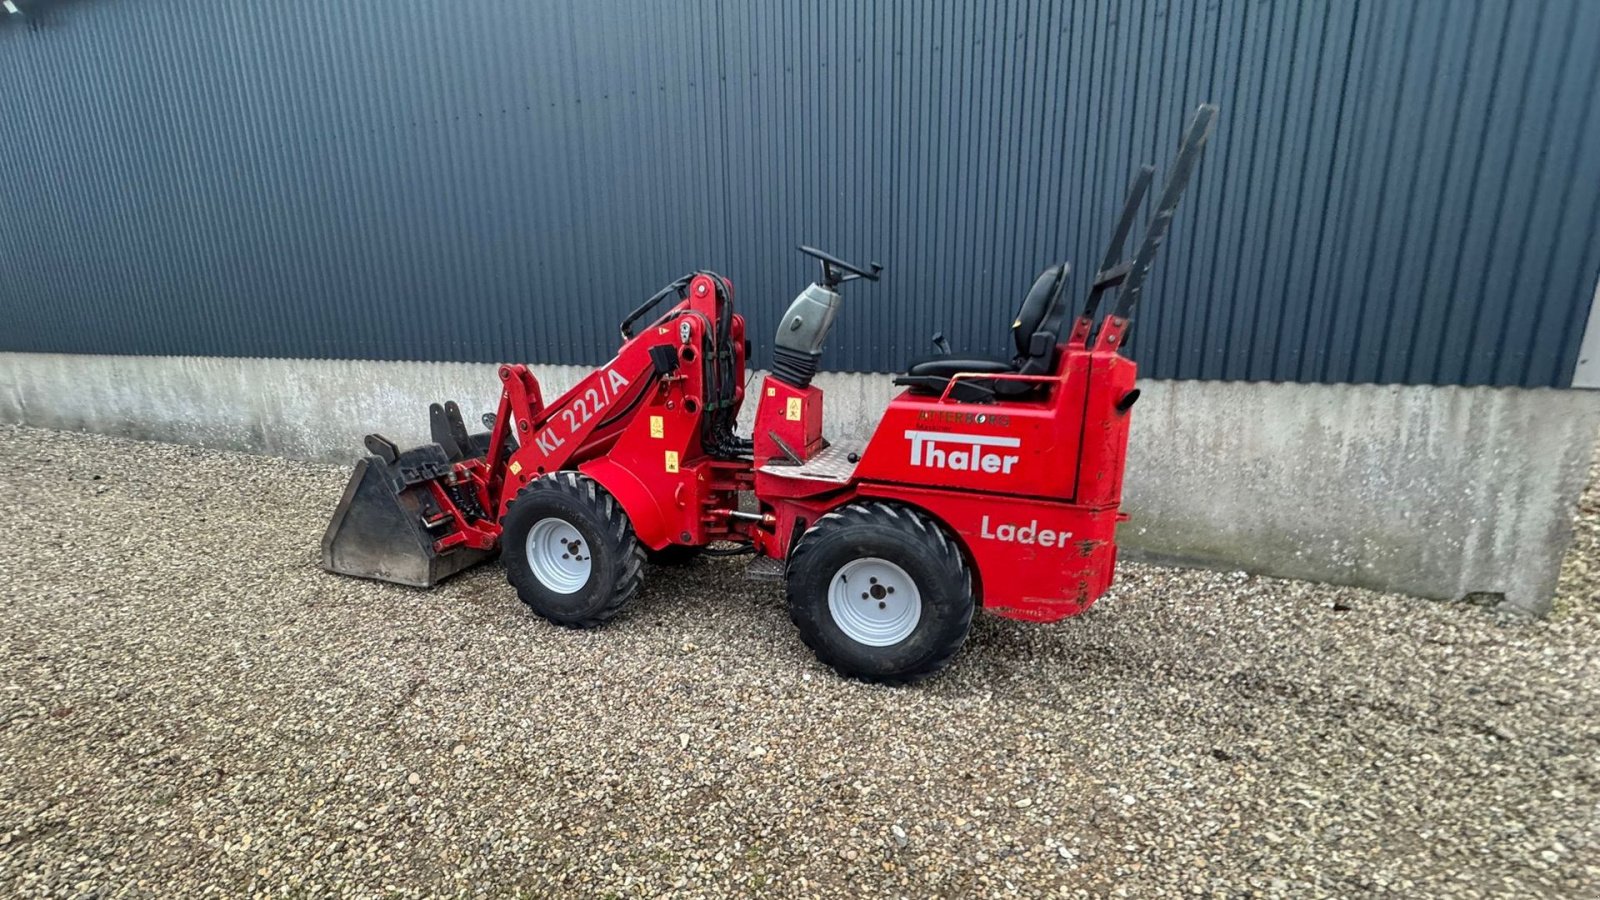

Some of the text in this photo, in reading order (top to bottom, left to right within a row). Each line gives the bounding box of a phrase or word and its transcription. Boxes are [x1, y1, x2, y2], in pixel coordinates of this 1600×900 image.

[535, 368, 629, 457] KL 222/A
[904, 430, 1021, 474] Thaler
[980, 515, 1072, 548] Lader
